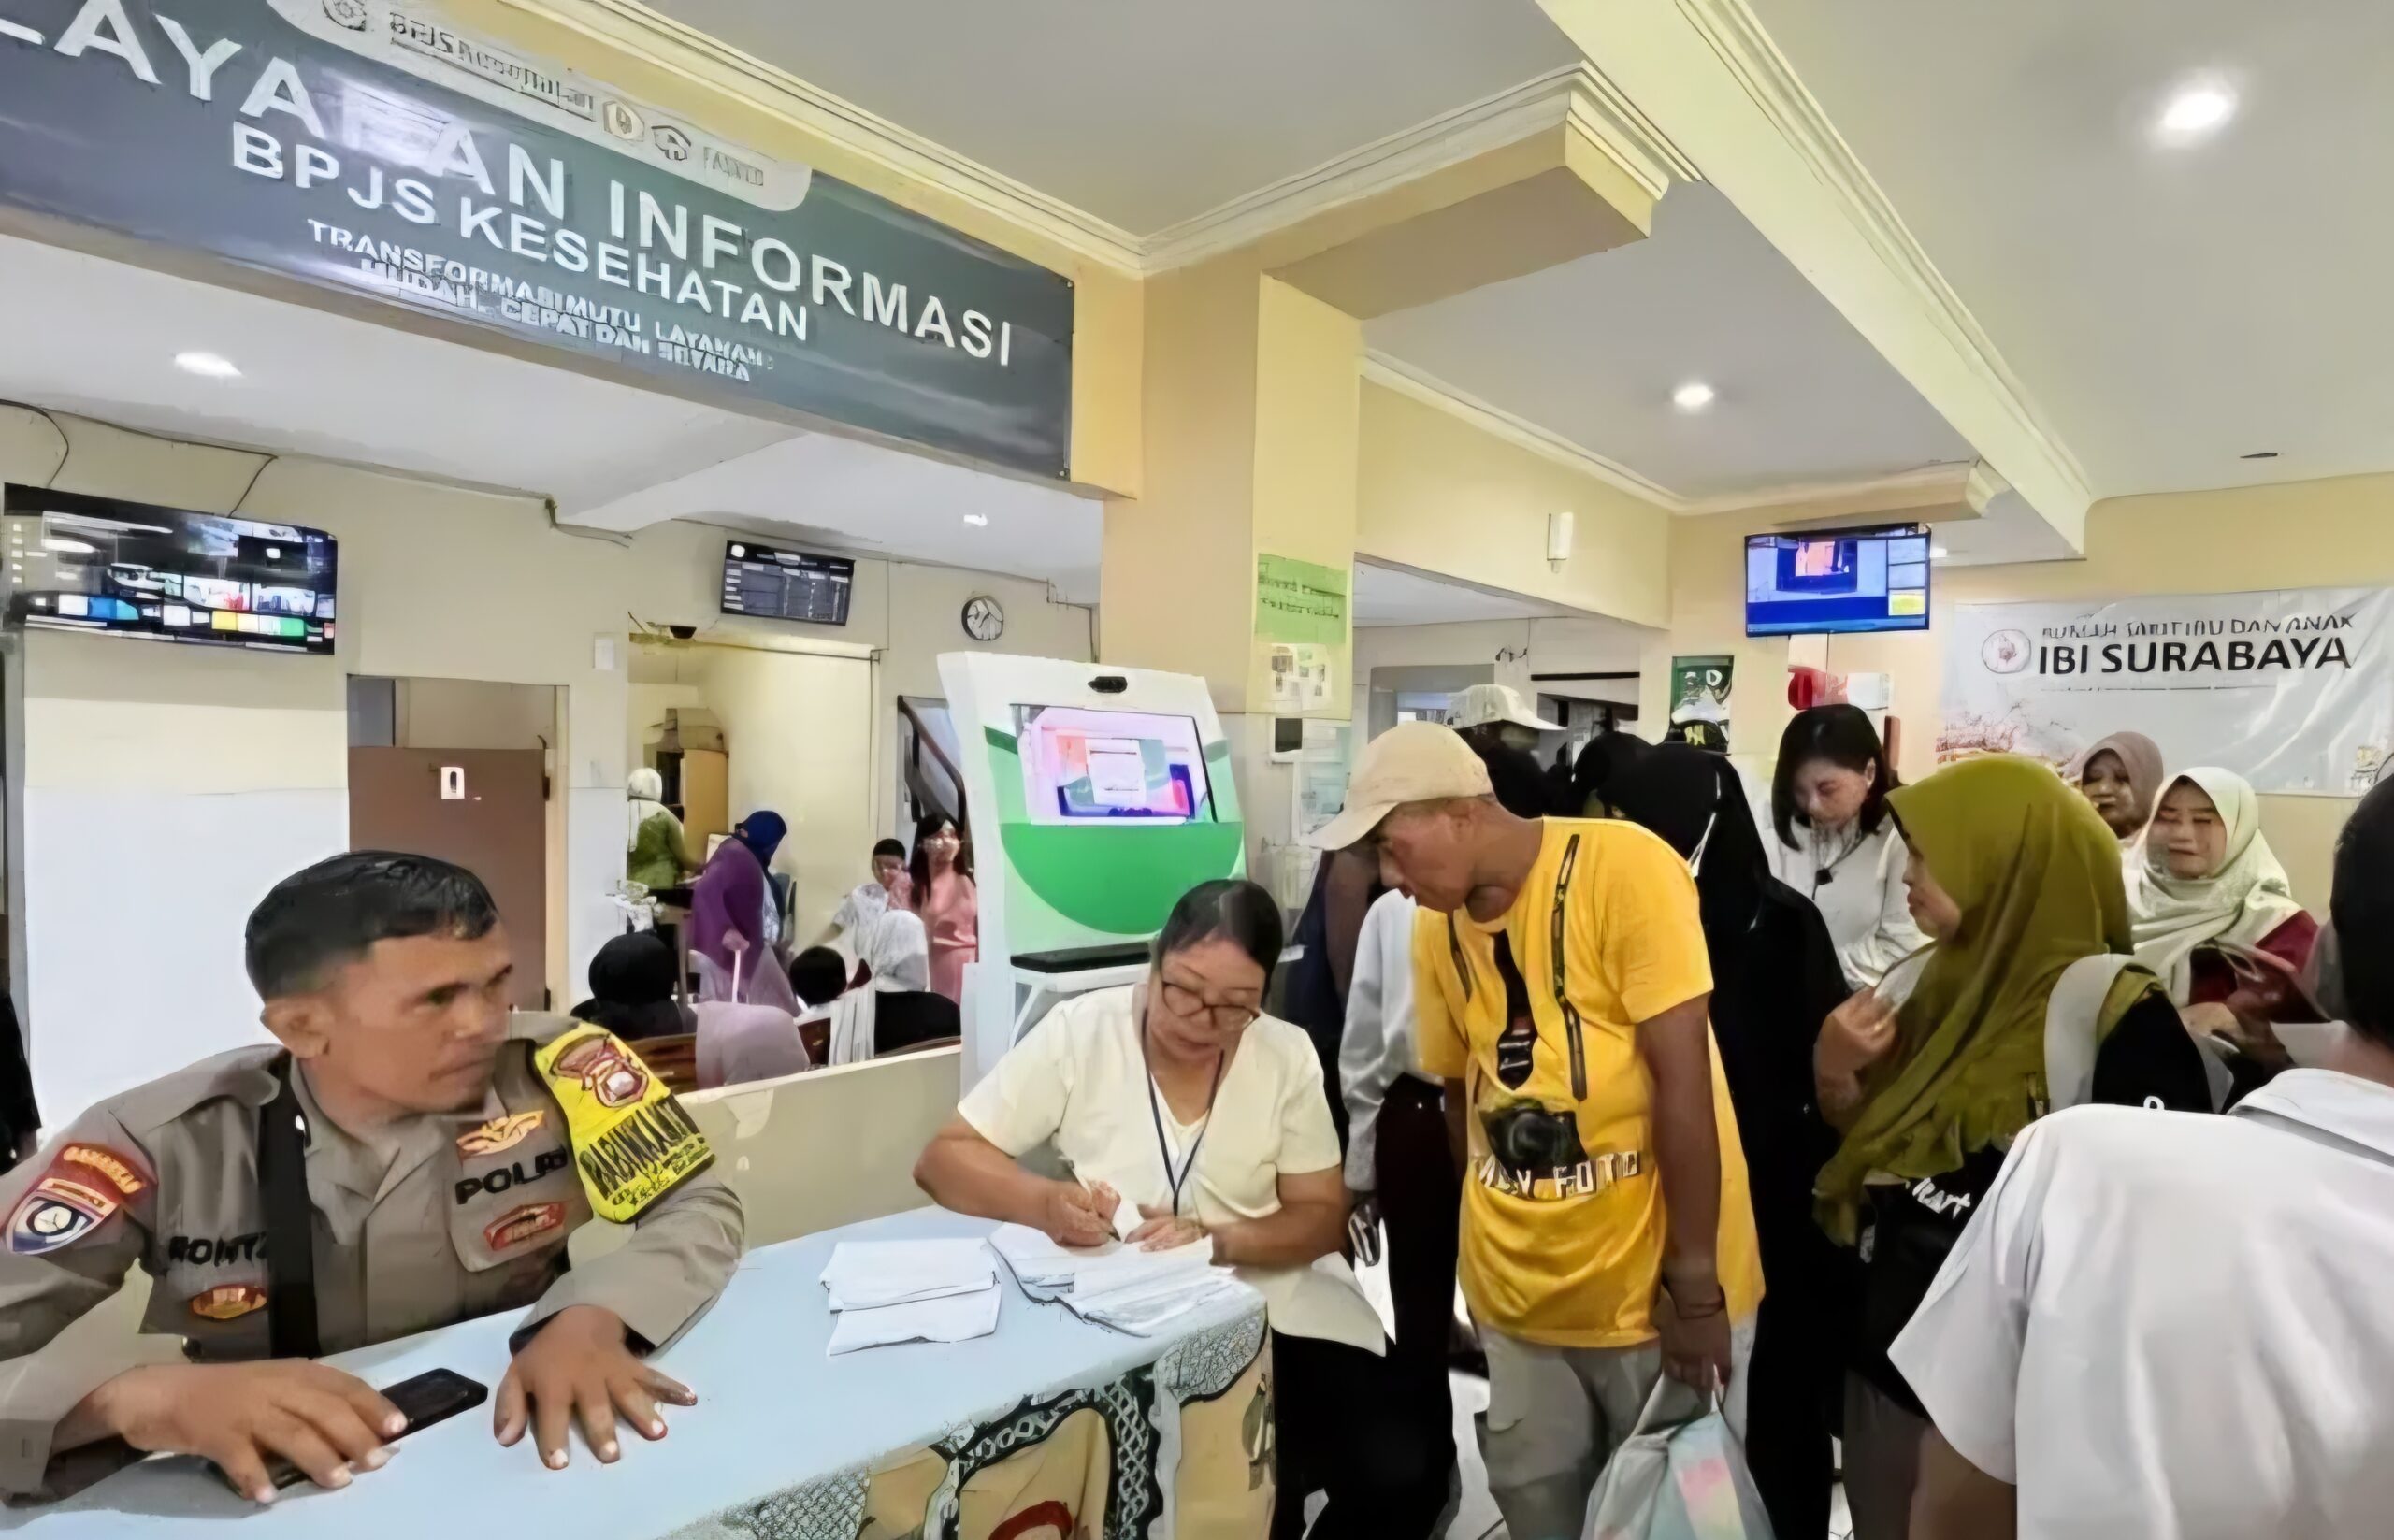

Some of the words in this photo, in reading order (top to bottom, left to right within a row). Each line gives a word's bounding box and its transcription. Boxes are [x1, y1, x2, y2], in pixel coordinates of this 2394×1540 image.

[0, 0, 565, 220] AYAAN
[610, 180, 1011, 367] INFORMASI
[232, 121, 440, 226] BPJS
[460, 196, 808, 342] KESEHATAN
[2039, 643, 2089, 675] IBI
[2101, 636, 2353, 674] SURABAYA
[2231, 617, 2282, 635] DAN
